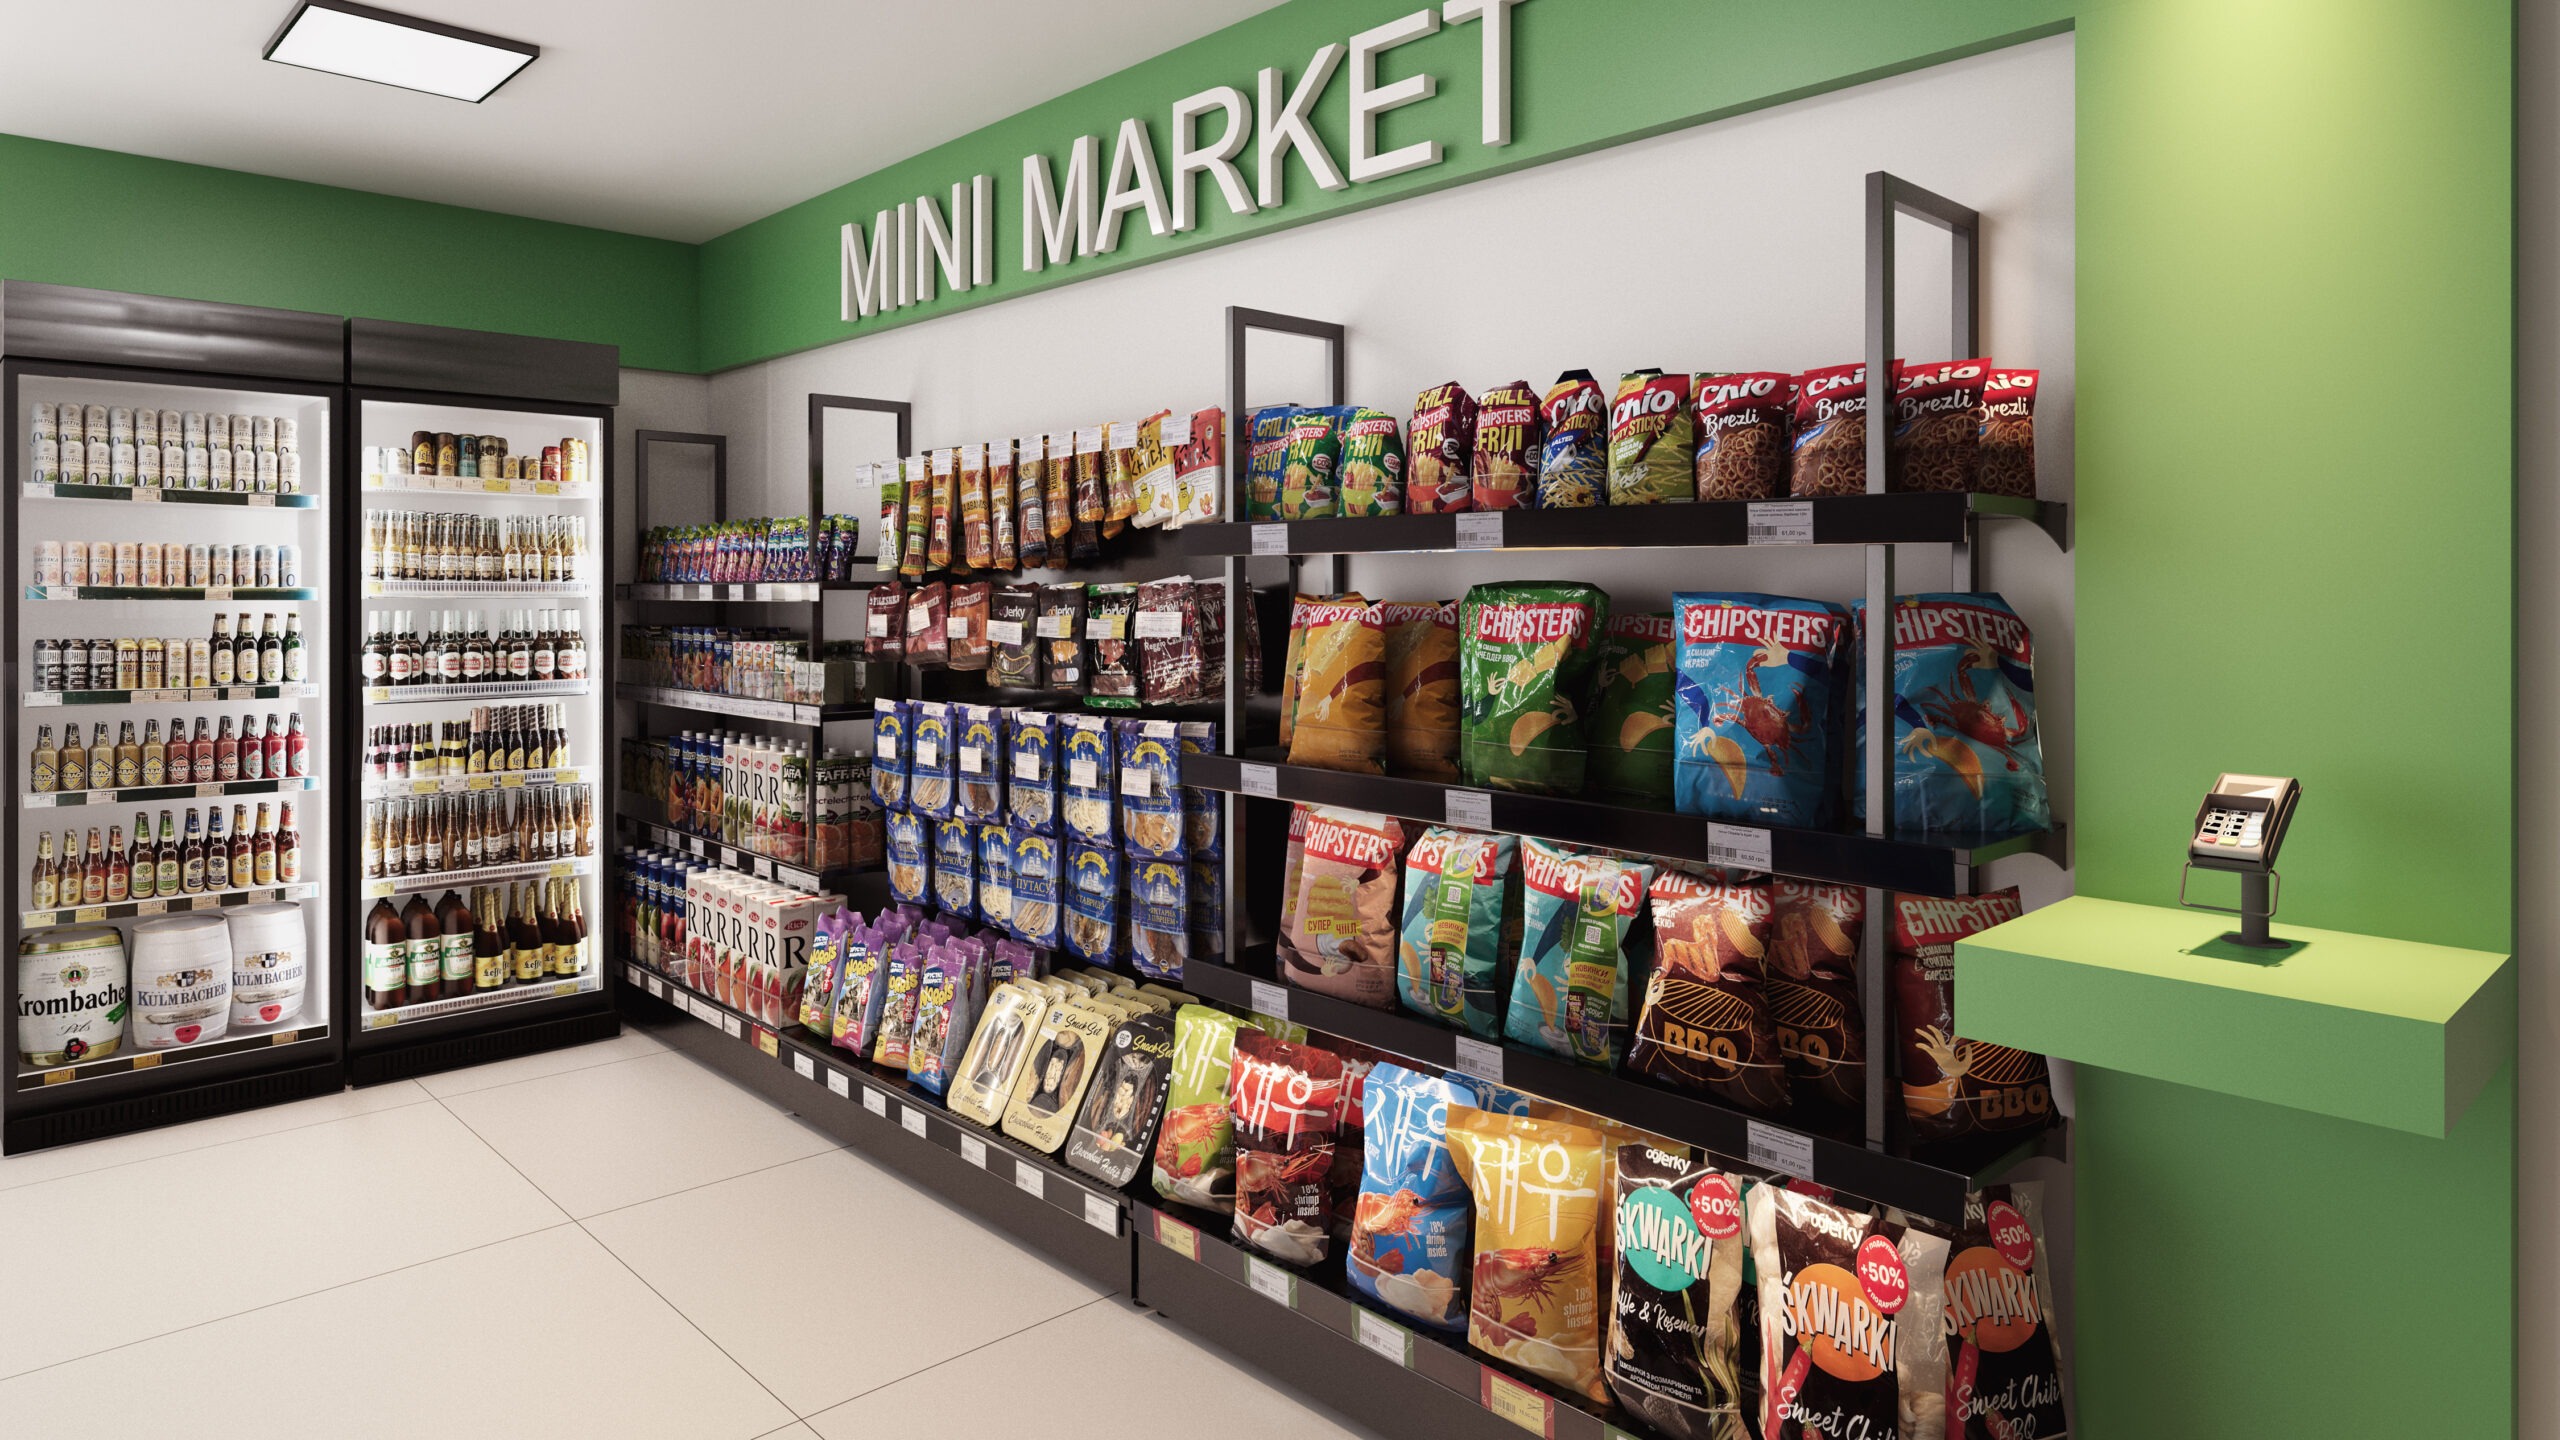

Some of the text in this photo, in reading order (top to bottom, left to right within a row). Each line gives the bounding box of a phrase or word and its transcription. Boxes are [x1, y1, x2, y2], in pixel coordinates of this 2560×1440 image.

[841, 0, 1517, 322] MINI MARKET
[1700, 379, 1777, 411] Chio
[1806, 368, 1866, 397] Chi
[1415, 386, 1453, 411] CHILL
[1481, 390, 1531, 406] CHILL
[1612, 388, 1675, 430] Chio
[1815, 397, 1867, 422] Brez
[1900, 389, 1973, 422] Brezli
[1629, 415, 1666, 437] STICKS
[1705, 408, 1760, 438] Brezli
[1688, 607, 1830, 649] CHIPSTER'S
[1894, 606, 2025, 654] HIPSTER'S
[725, 768, 734, 795] R
[740, 771, 750, 798] R
[784, 767, 801, 779] JAFFA
[754, 773, 764, 802] R
[769, 776, 780, 805] R
[1304, 820, 1394, 863] CHIPSTER'S
[1015, 877, 1051, 894] ПУТАСУ
[687, 901, 698, 934] R
[702, 906, 713, 940] R
[717, 911, 728, 946] R
[1307, 918, 1332, 932] СУПЕР
[1438, 922, 1464, 933] НОВИНКИ
[732, 917, 743, 952] R
[748, 926, 760, 961] R
[765, 932, 777, 968] R
[784, 935, 809, 969] R
[1575, 964, 1609, 978] НОВИНКИ
[137, 982, 228, 1007] KULMBACHER
[56, 1018, 93, 1037] Pils
[1064, 1013, 1088, 1031] Snack
[1086, 1021, 1103, 1037] Set
[1132, 1034, 1158, 1054] Snack
[1156, 1042, 1176, 1059] Set
[1663, 1021, 1738, 1071] BBQ
[1229, 1060, 1329, 1151] 새우
[1980, 1086, 2050, 1121] BBQ
[1100, 1157, 1122, 1183] Набір
[1294, 1194, 1320, 1208] shrimp
[1471, 1133, 1597, 1242] 새우
[1297, 1204, 1320, 1217] inside
[1694, 1195, 1740, 1217] +50%
[1429, 1221, 1446, 1233] 18%
[1995, 1224, 2030, 1246] +50%
[1425, 1235, 1446, 1248] shrimp
[1426, 1246, 1448, 1258] inside
[1869, 1240, 1898, 1262] ПОДАРУНОК
[1861, 1262, 1905, 1289] +50%
[1575, 1287, 1592, 1300] 18%
[1870, 1293, 1902, 1309] ПОДАРУНОК
[1563, 1300, 1593, 1317] shrimp
[1566, 1313, 1593, 1330] inside
[1639, 1302, 1709, 1340] & Rosemar
[1779, 1270, 1898, 1373] ŚKWARKI
[1620, 1359, 1646, 1376] ШКВАРКИ
[1651, 1374, 1695, 1394] РОЗМАРИНОМ
[1694, 1387, 1703, 1396] ТА
[1630, 1374, 1692, 1401] АРОМАТОМ ТРЮФЕЛЯ
[1776, 1384, 1843, 1438] Sweet
[1956, 1373, 2060, 1423] Sweet Chili
[1996, 1413, 2037, 1440] BBQ
